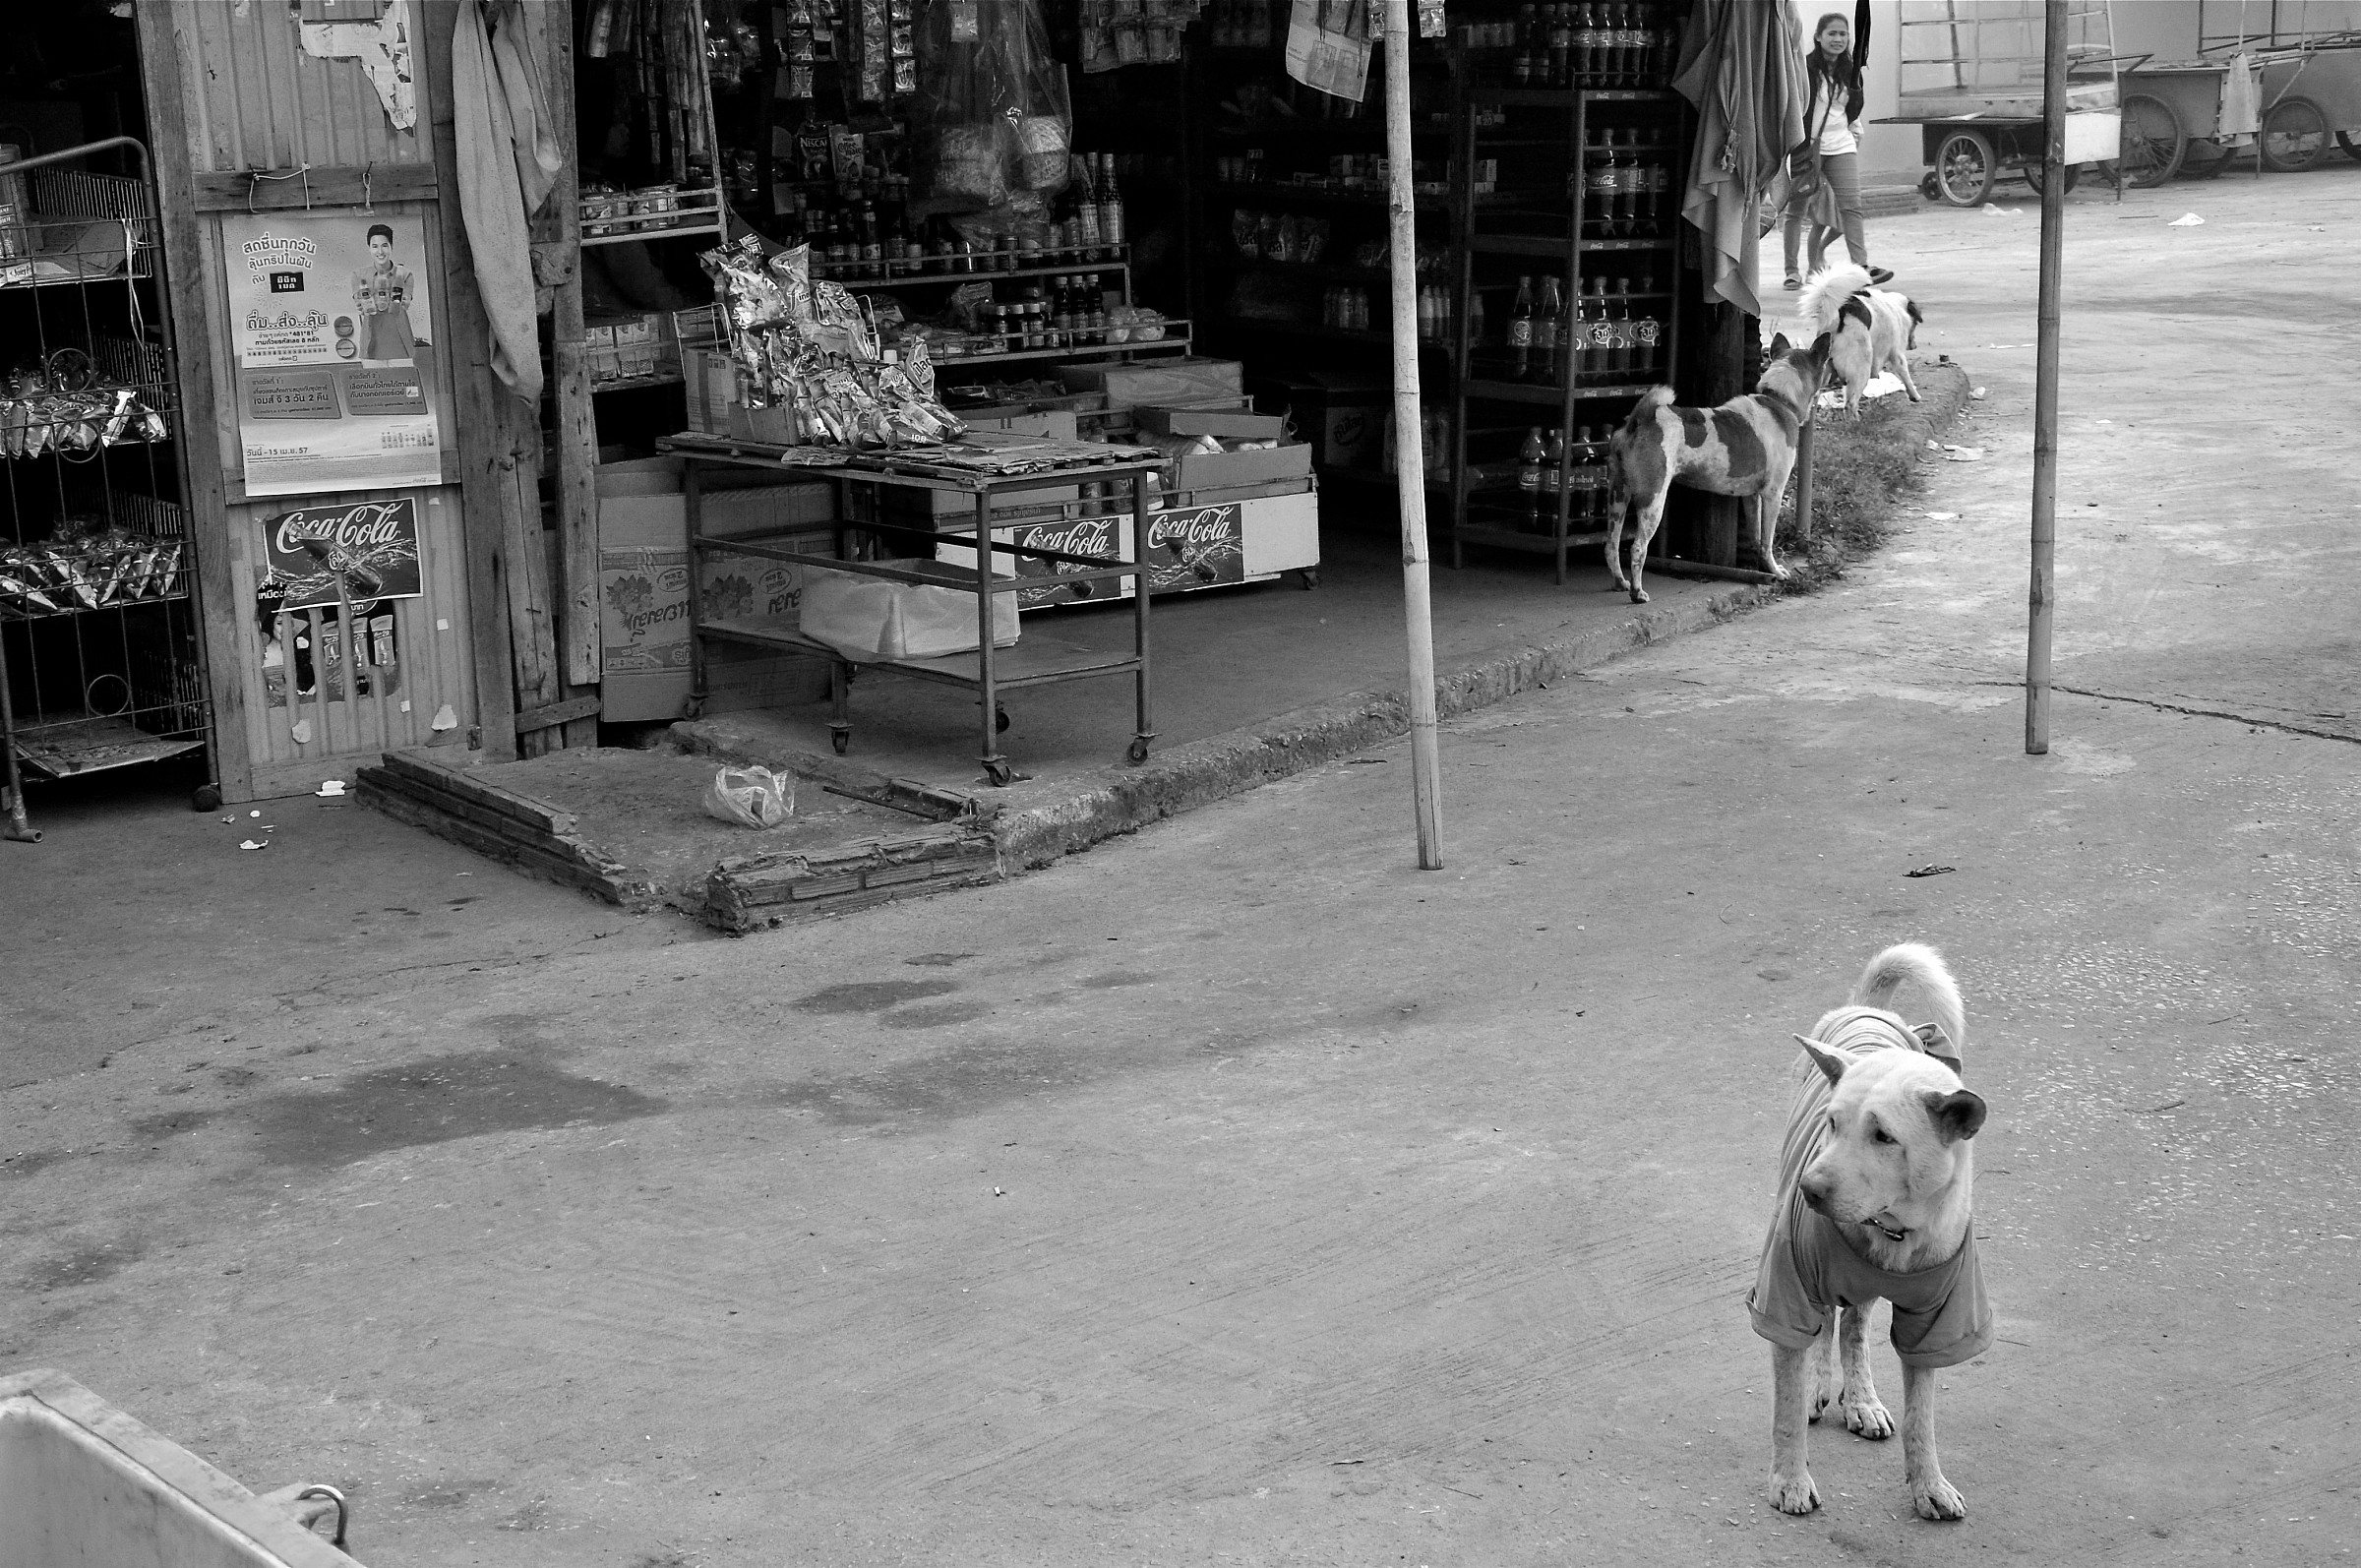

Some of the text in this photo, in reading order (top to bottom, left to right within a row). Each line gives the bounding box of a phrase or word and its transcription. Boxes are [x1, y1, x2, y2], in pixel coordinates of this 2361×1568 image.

[243, 232, 315, 255] สดชื่นทุกวัน
[248, 253, 312, 271] ลุ้นทริปในฝัน
[252, 274, 266, 285] กับ
[254, 394, 274, 405] เจมส์
[293, 393, 306, 403] วัน
[308, 393, 315, 402] 2
[316, 392, 329, 402] คืน
[246, 446, 263, 456] วันนี้
